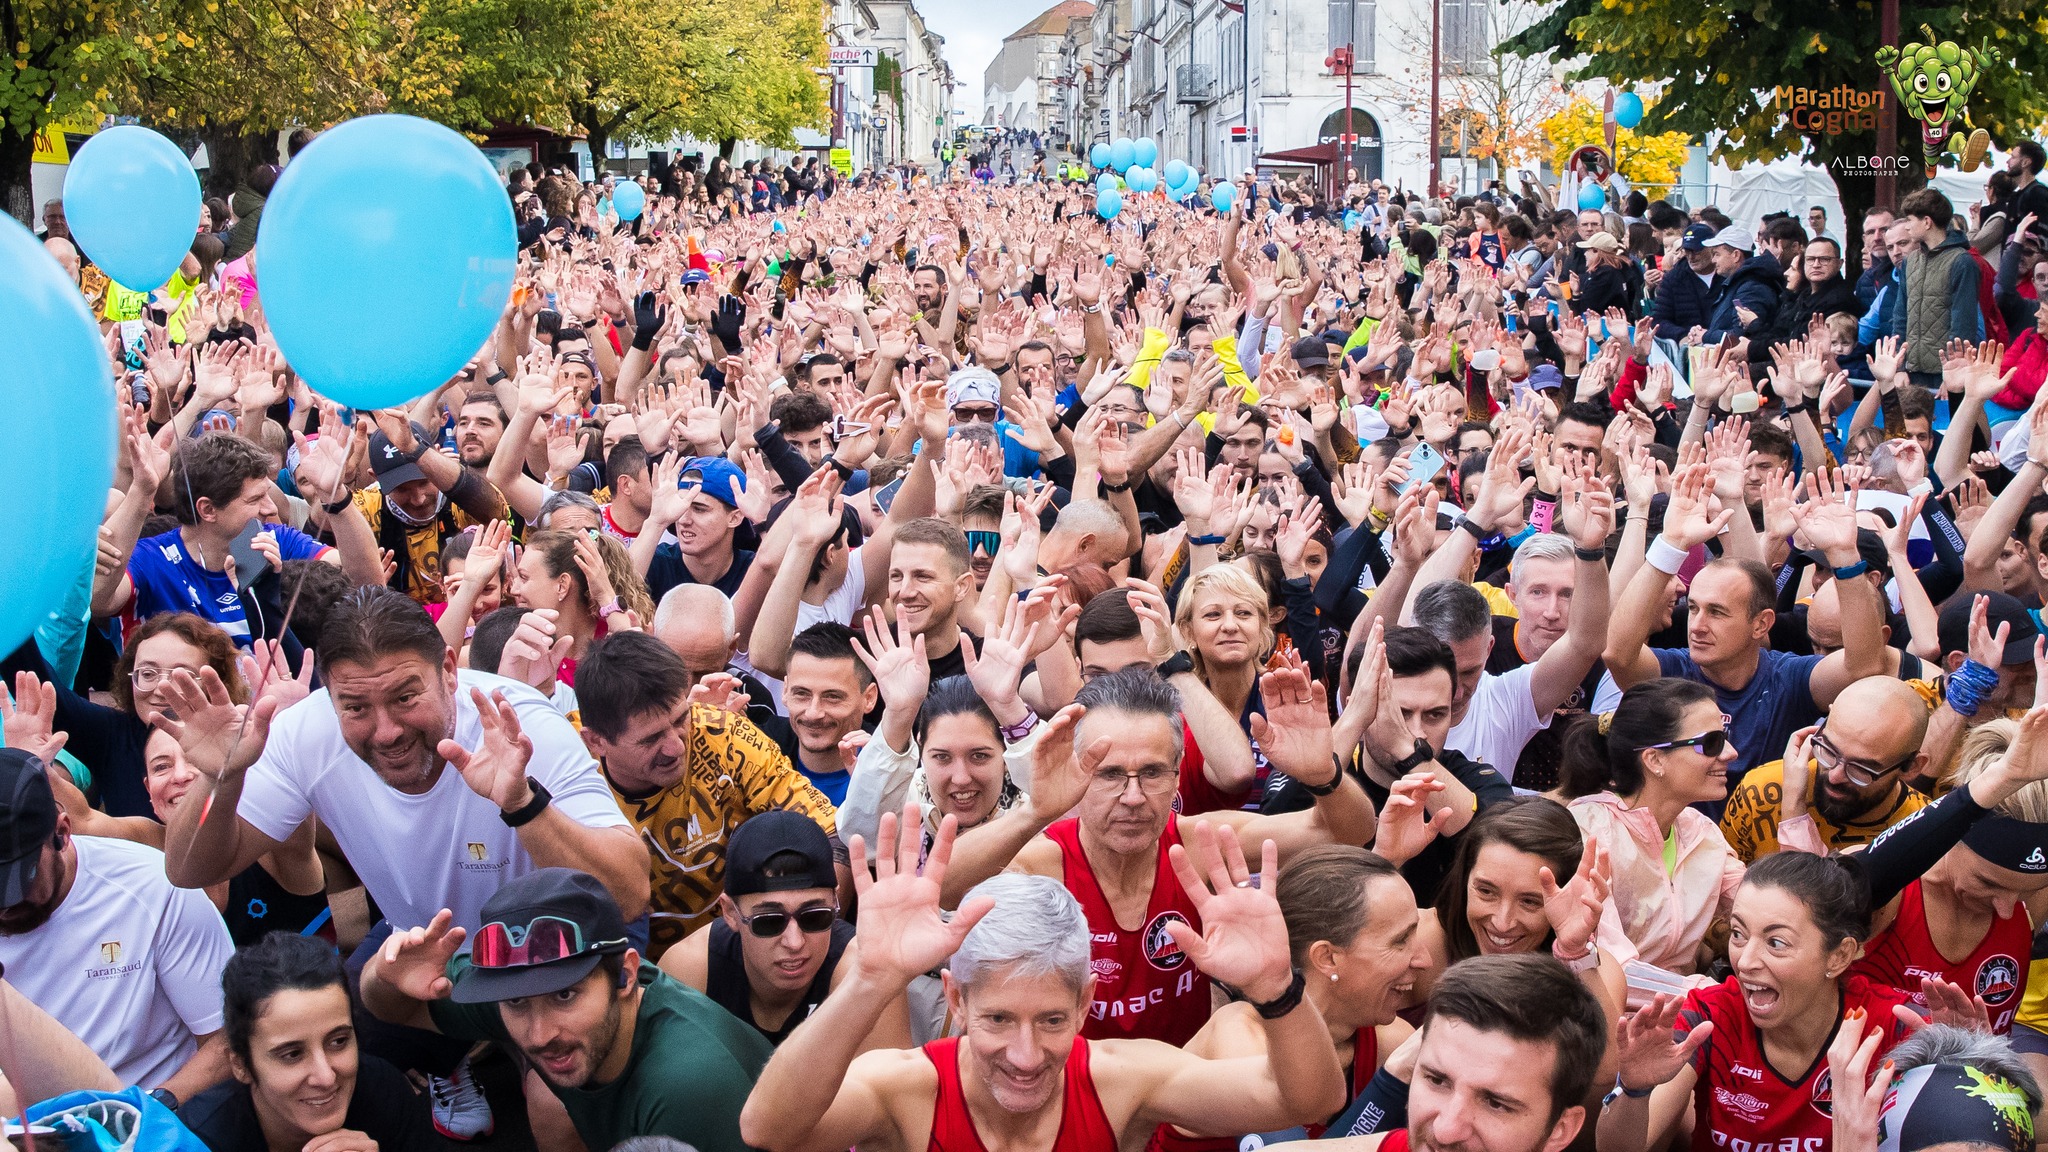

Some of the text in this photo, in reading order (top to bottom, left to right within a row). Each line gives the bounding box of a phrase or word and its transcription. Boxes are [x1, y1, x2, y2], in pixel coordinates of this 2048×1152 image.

[1931, 510, 1965, 553] CHAMPAGNE
[220, 604, 241, 613] umbro
[456, 858, 511, 870] Taransaud
[85, 960, 141, 979] Taransaud
[1089, 987, 1164, 1021] gnac
